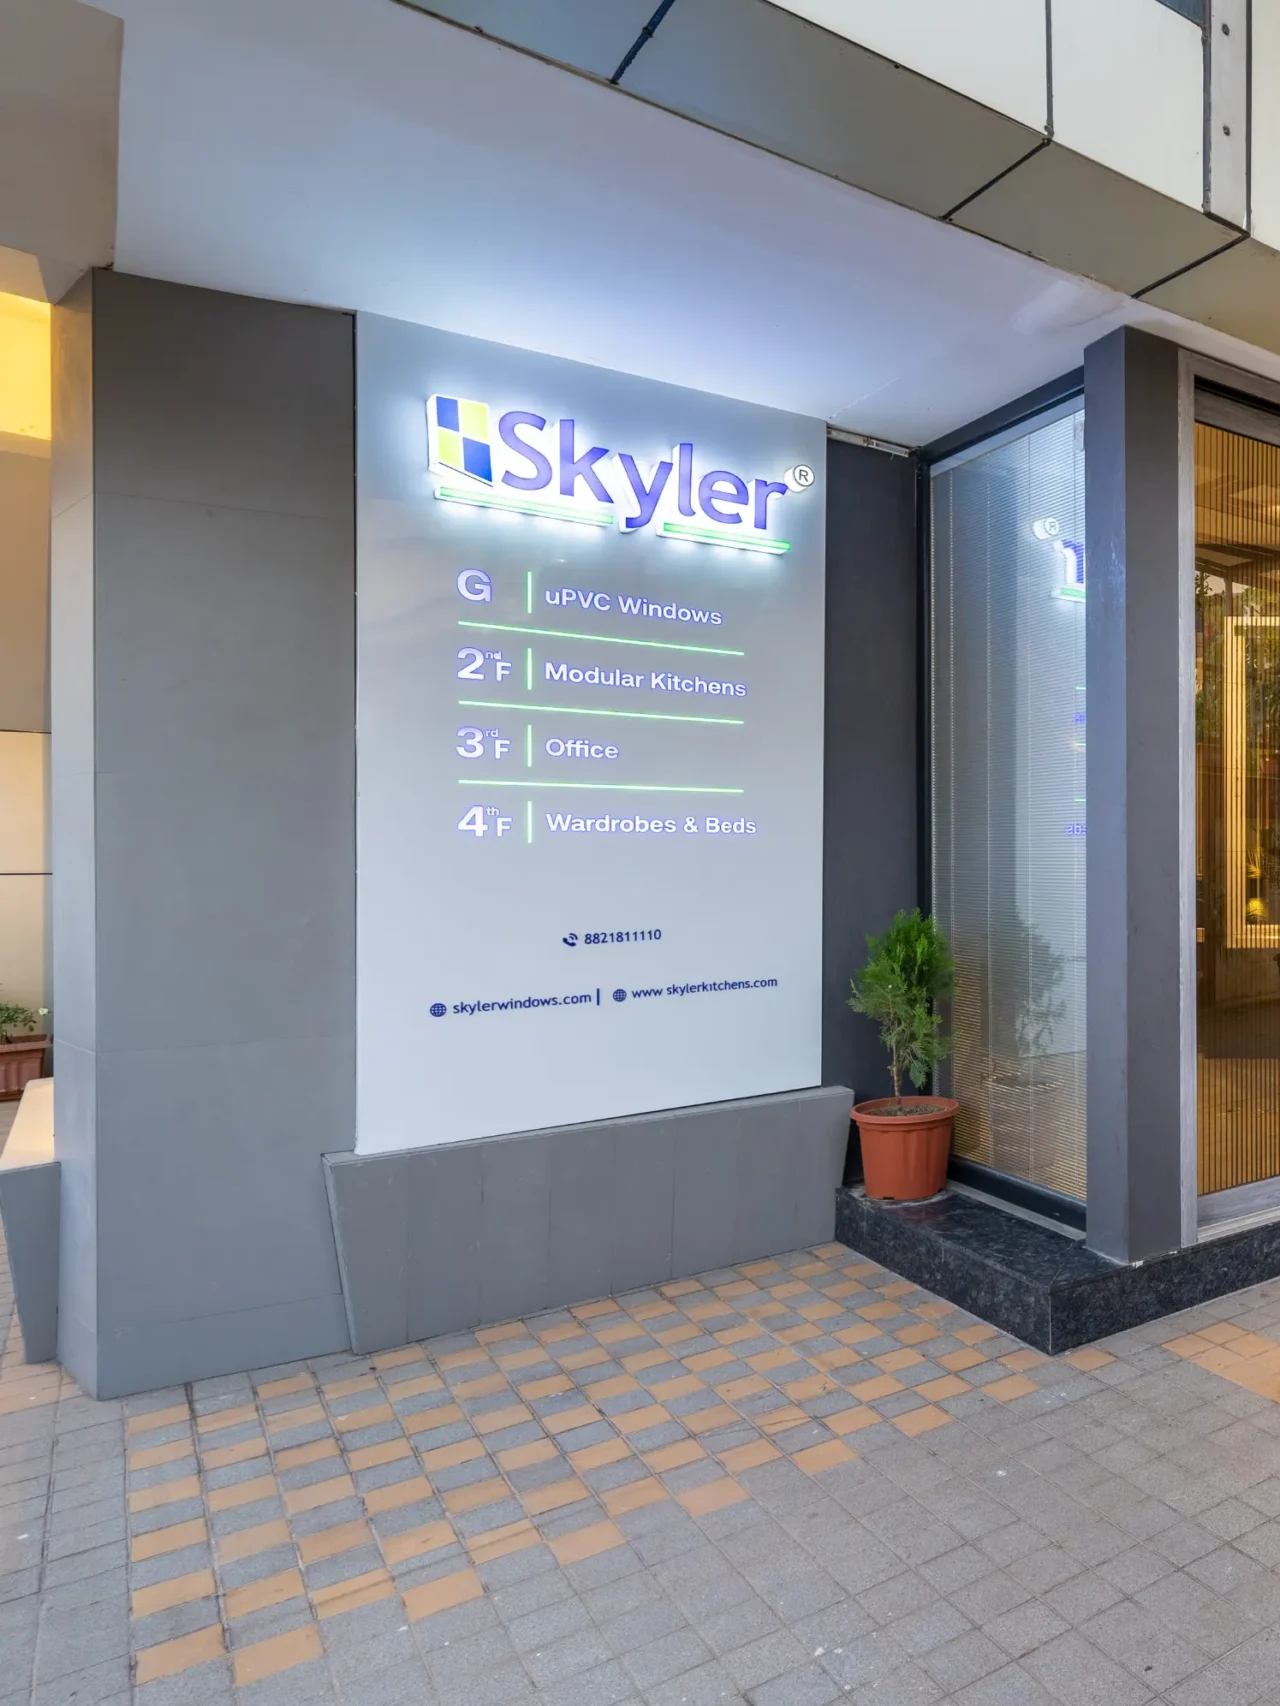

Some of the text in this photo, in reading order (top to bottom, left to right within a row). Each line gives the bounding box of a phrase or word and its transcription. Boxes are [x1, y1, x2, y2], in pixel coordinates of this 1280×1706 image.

[498, 411, 788, 530] Skyler
[457, 568, 492, 602] G
[544, 588, 722, 625] uPVC Windows
[545, 661, 747, 696] Modular Kitchens
[545, 737, 619, 759] Office
[546, 812, 757, 835] Wardrobes & Beds
[584, 928, 662, 945] 8821811110
[452, 993, 592, 1016] skylerwindows.com
